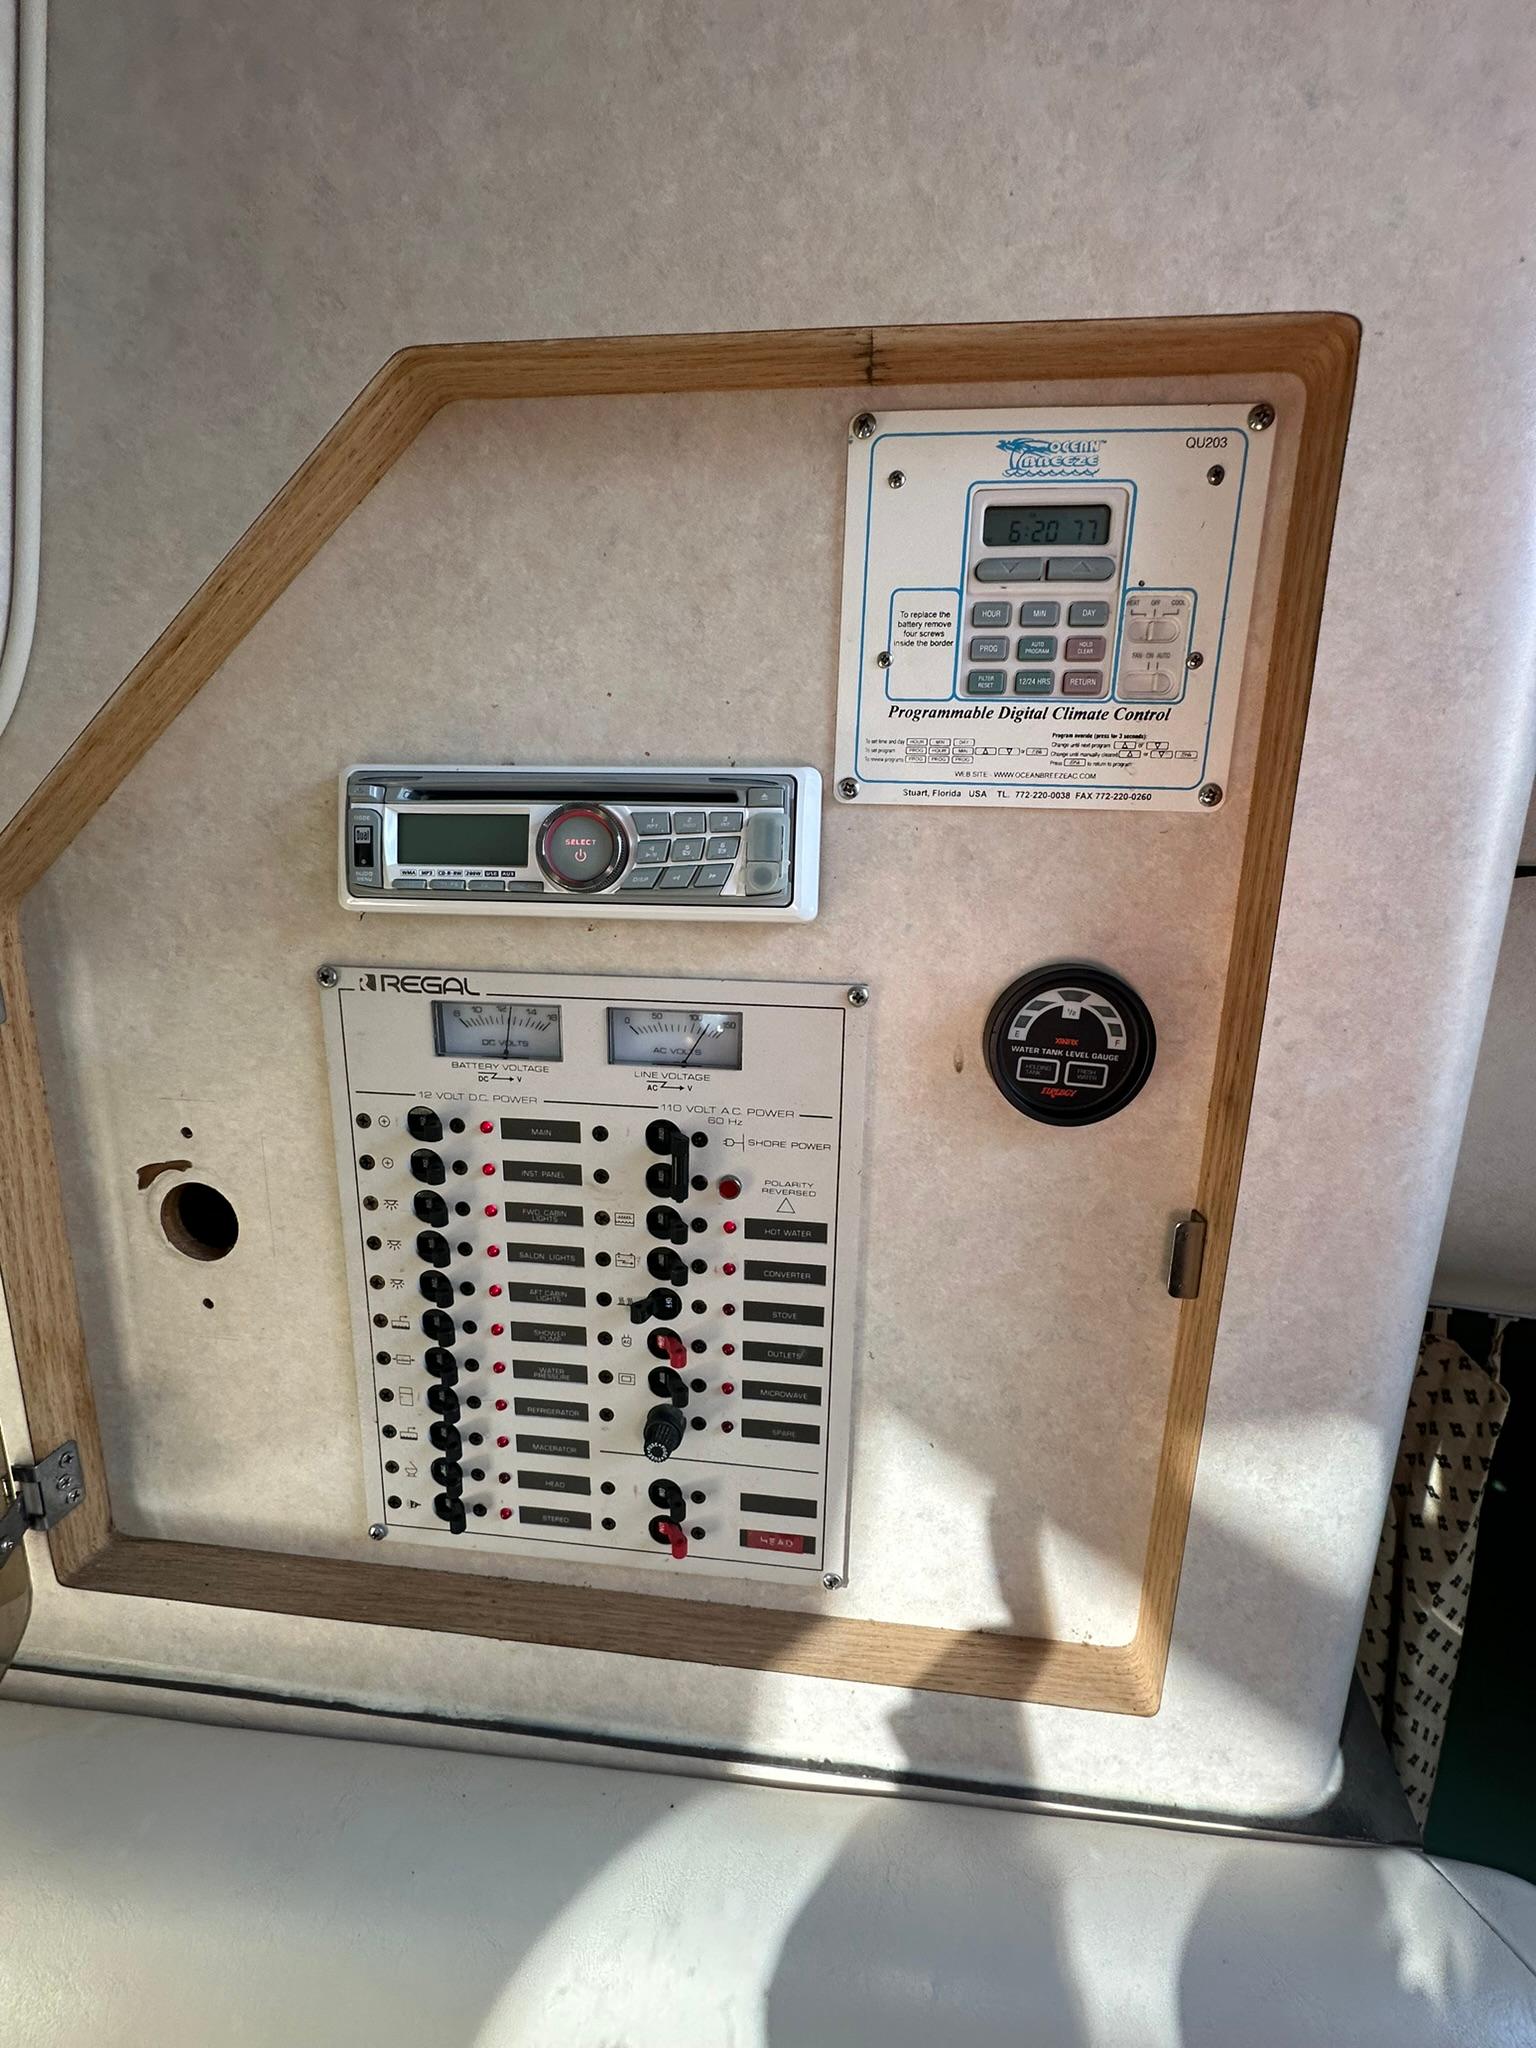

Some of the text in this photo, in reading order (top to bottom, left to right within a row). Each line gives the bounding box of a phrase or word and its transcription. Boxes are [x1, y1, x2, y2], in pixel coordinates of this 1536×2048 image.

[1049, 439, 1100, 453] OCEAN
[1185, 436, 1228, 449] QU203
[1021, 454, 1099, 467] BREEZE
[1008, 520, 1098, 542] 6:20 77
[900, 610, 951, 620] To replace the
[982, 609, 1001, 618] HOUR
[1033, 609, 1047, 618] MIN
[1082, 609, 1096, 617] DAY
[897, 620, 923, 630] battery
[903, 630, 918, 638] four
[894, 639, 954, 647] inside the border
[979, 644, 998, 653] PROG
[1019, 677, 1051, 686] 12/24 HRS
[1070, 677, 1097, 686] RETURN
[888, 704, 1172, 723] Programmable Digital Climate Control
[902, 788, 930, 797] Stuart,
[932, 789, 962, 797] Florida
[968, 790, 987, 798] USA
[1015, 791, 1071, 799] 772-220-0038
[1075, 792, 1093, 800] FAX
[1095, 792, 1152, 801] 772-220-0260
[565, 838, 597, 846] SELECT
[380, 973, 481, 996] REGAL
[472, 1006, 482, 1014] 10
[496, 1005, 507, 1013] 12
[624, 1016, 631, 1025] 0
[651, 1012, 663, 1021] 50
[1014, 1030, 1020, 1038] E
[481, 1038, 529, 1047] DC VOLTS
[1114, 1039, 1121, 1047] F
[653, 1047, 702, 1056] AC VOLTS
[1011, 1045, 1120, 1062] WATER TANK LEVEL GAUGE
[451, 1060, 550, 1073] BATTERY VOLTAGE
[634, 1071, 711, 1082] LINE VOLTAGE
[647, 1084, 658, 1092] AC
[419, 1090, 433, 1099] 12
[435, 1092, 465, 1101] VOLT
[492, 1094, 538, 1104] POWER
[660, 1103, 683, 1113] 110
[685, 1104, 717, 1114] VOLT
[746, 1107, 795, 1119] POWER
[707, 1116, 744, 1126] 60 Hz
[530, 1128, 552, 1137] MAIN
[747, 1138, 832, 1151] SHORE POWER
[521, 1169, 566, 1179] INST PANEL
[764, 1179, 814, 1189] POLARITY
[761, 1188, 817, 1198] REVERSED
[543, 1209, 567, 1217] CABIN
[531, 1215, 558, 1223] LIGHTS
[764, 1228, 812, 1238] HOT WATER
[549, 1253, 576, 1262] LIGHTS
[763, 1270, 811, 1280] CONVERTER
[529, 1288, 568, 1298] AFT CABIN
[772, 1311, 797, 1320] STOVE
[533, 1329, 567, 1337] SHOWER
[539, 1335, 561, 1343] PUMP
[767, 1350, 801, 1360] OUTLETS
[539, 1366, 565, 1375] WATER
[759, 1388, 808, 1400] MICROWAVE
[527, 1406, 580, 1417] REFRIGERATOR
[771, 1429, 796, 1438] SPARE
[532, 1443, 577, 1453] MACERATOR
[544, 1479, 566, 1489] HEAD
[542, 1515, 570, 1524] STEREO
